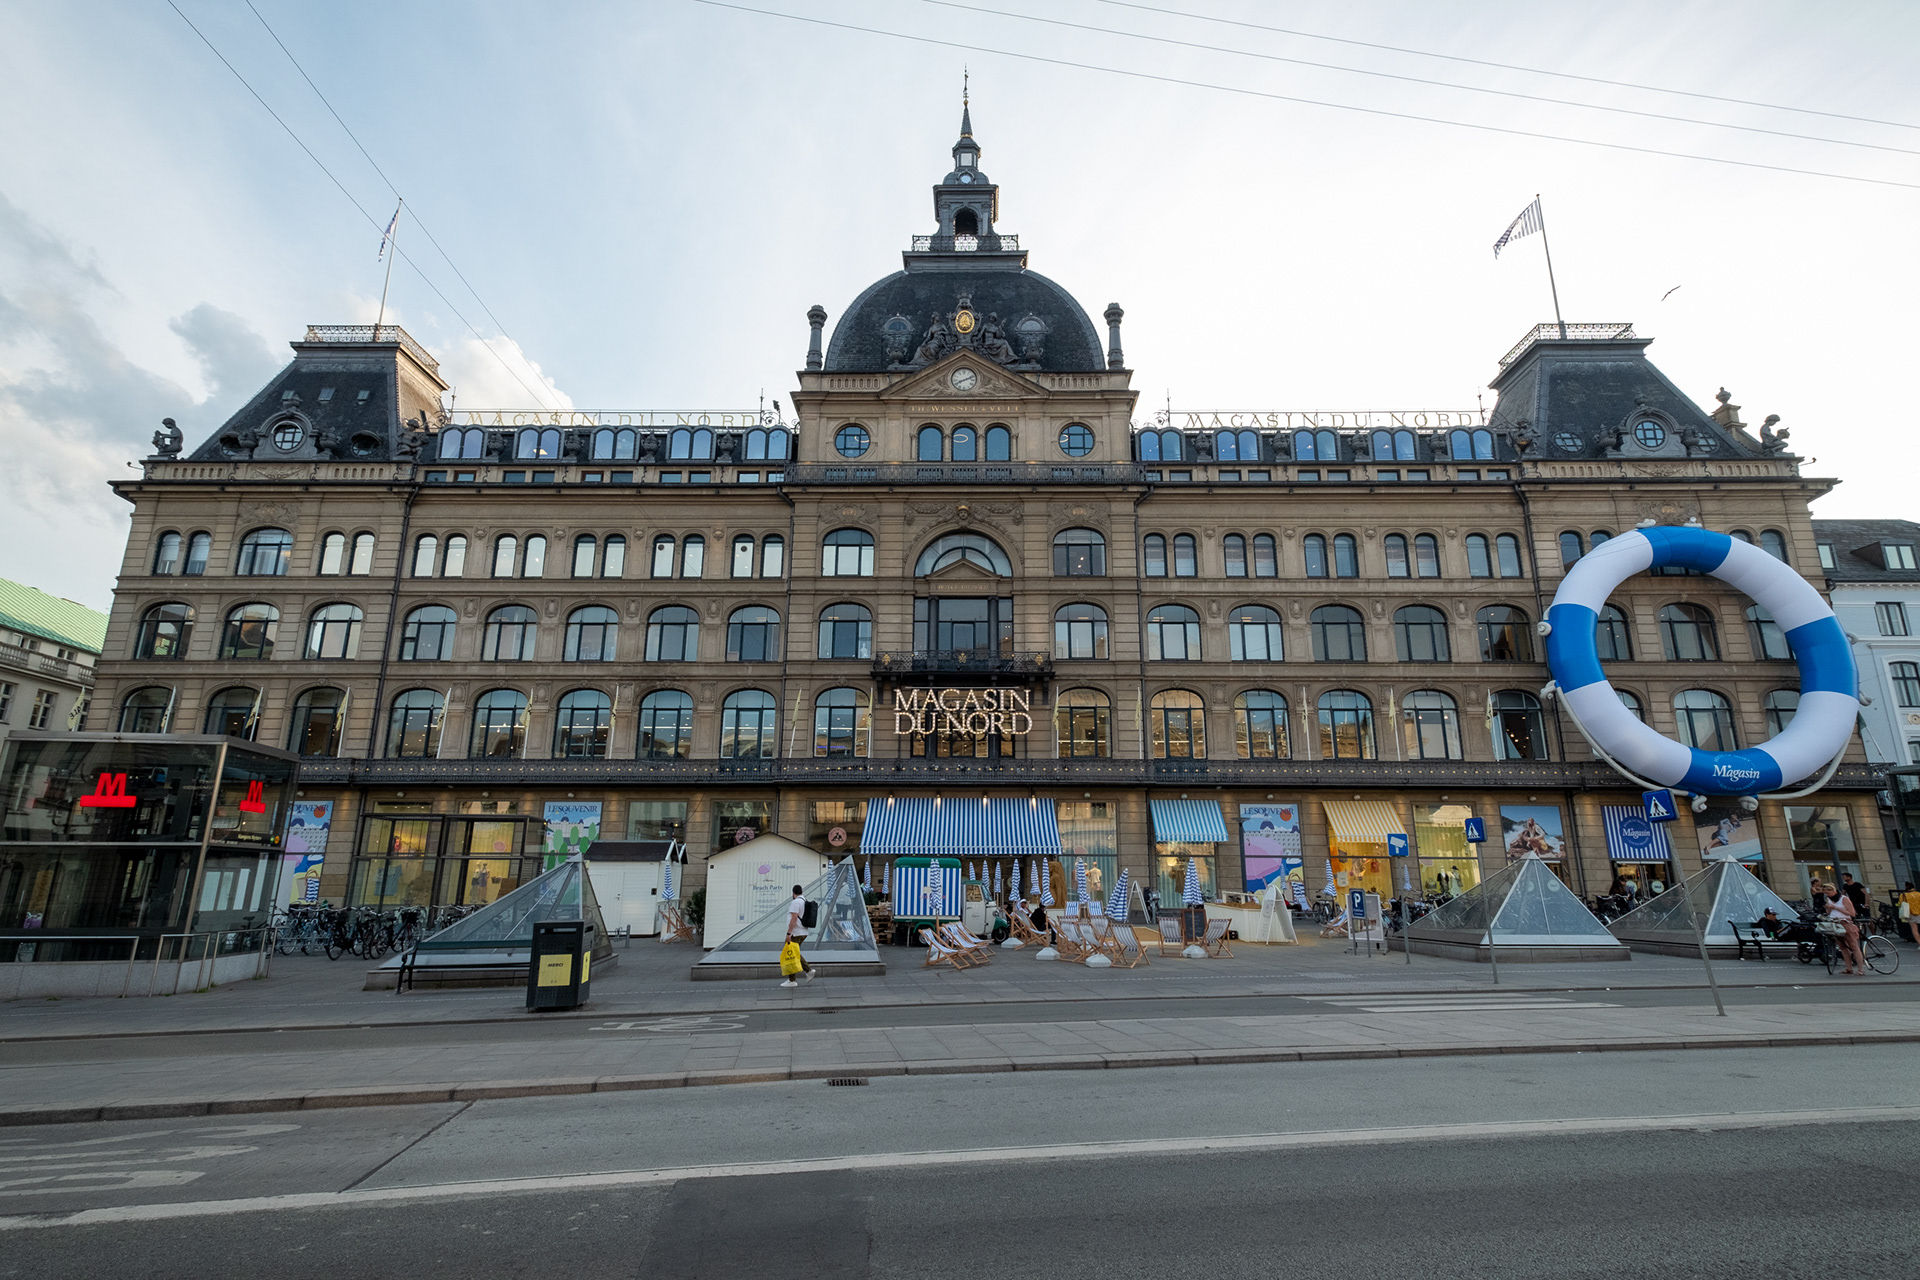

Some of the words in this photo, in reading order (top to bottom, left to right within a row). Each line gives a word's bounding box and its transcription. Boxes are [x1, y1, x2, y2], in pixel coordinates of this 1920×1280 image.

[466, 413, 598, 427] MAGASIN
[618, 413, 653, 427] DU
[675, 413, 756, 427] NORD
[1184, 413, 1317, 428] MAGASIN
[1330, 413, 1370, 428] DU
[1389, 413, 1472, 428] NORD
[894, 689, 1031, 711] MAGASIN
[894, 712, 936, 735] DU
[946, 712, 1033, 735] NORD
[1713, 764, 1760, 782] Magasin
[1622, 828, 1651, 839] Magasin
[1354, 893, 1361, 908] P
